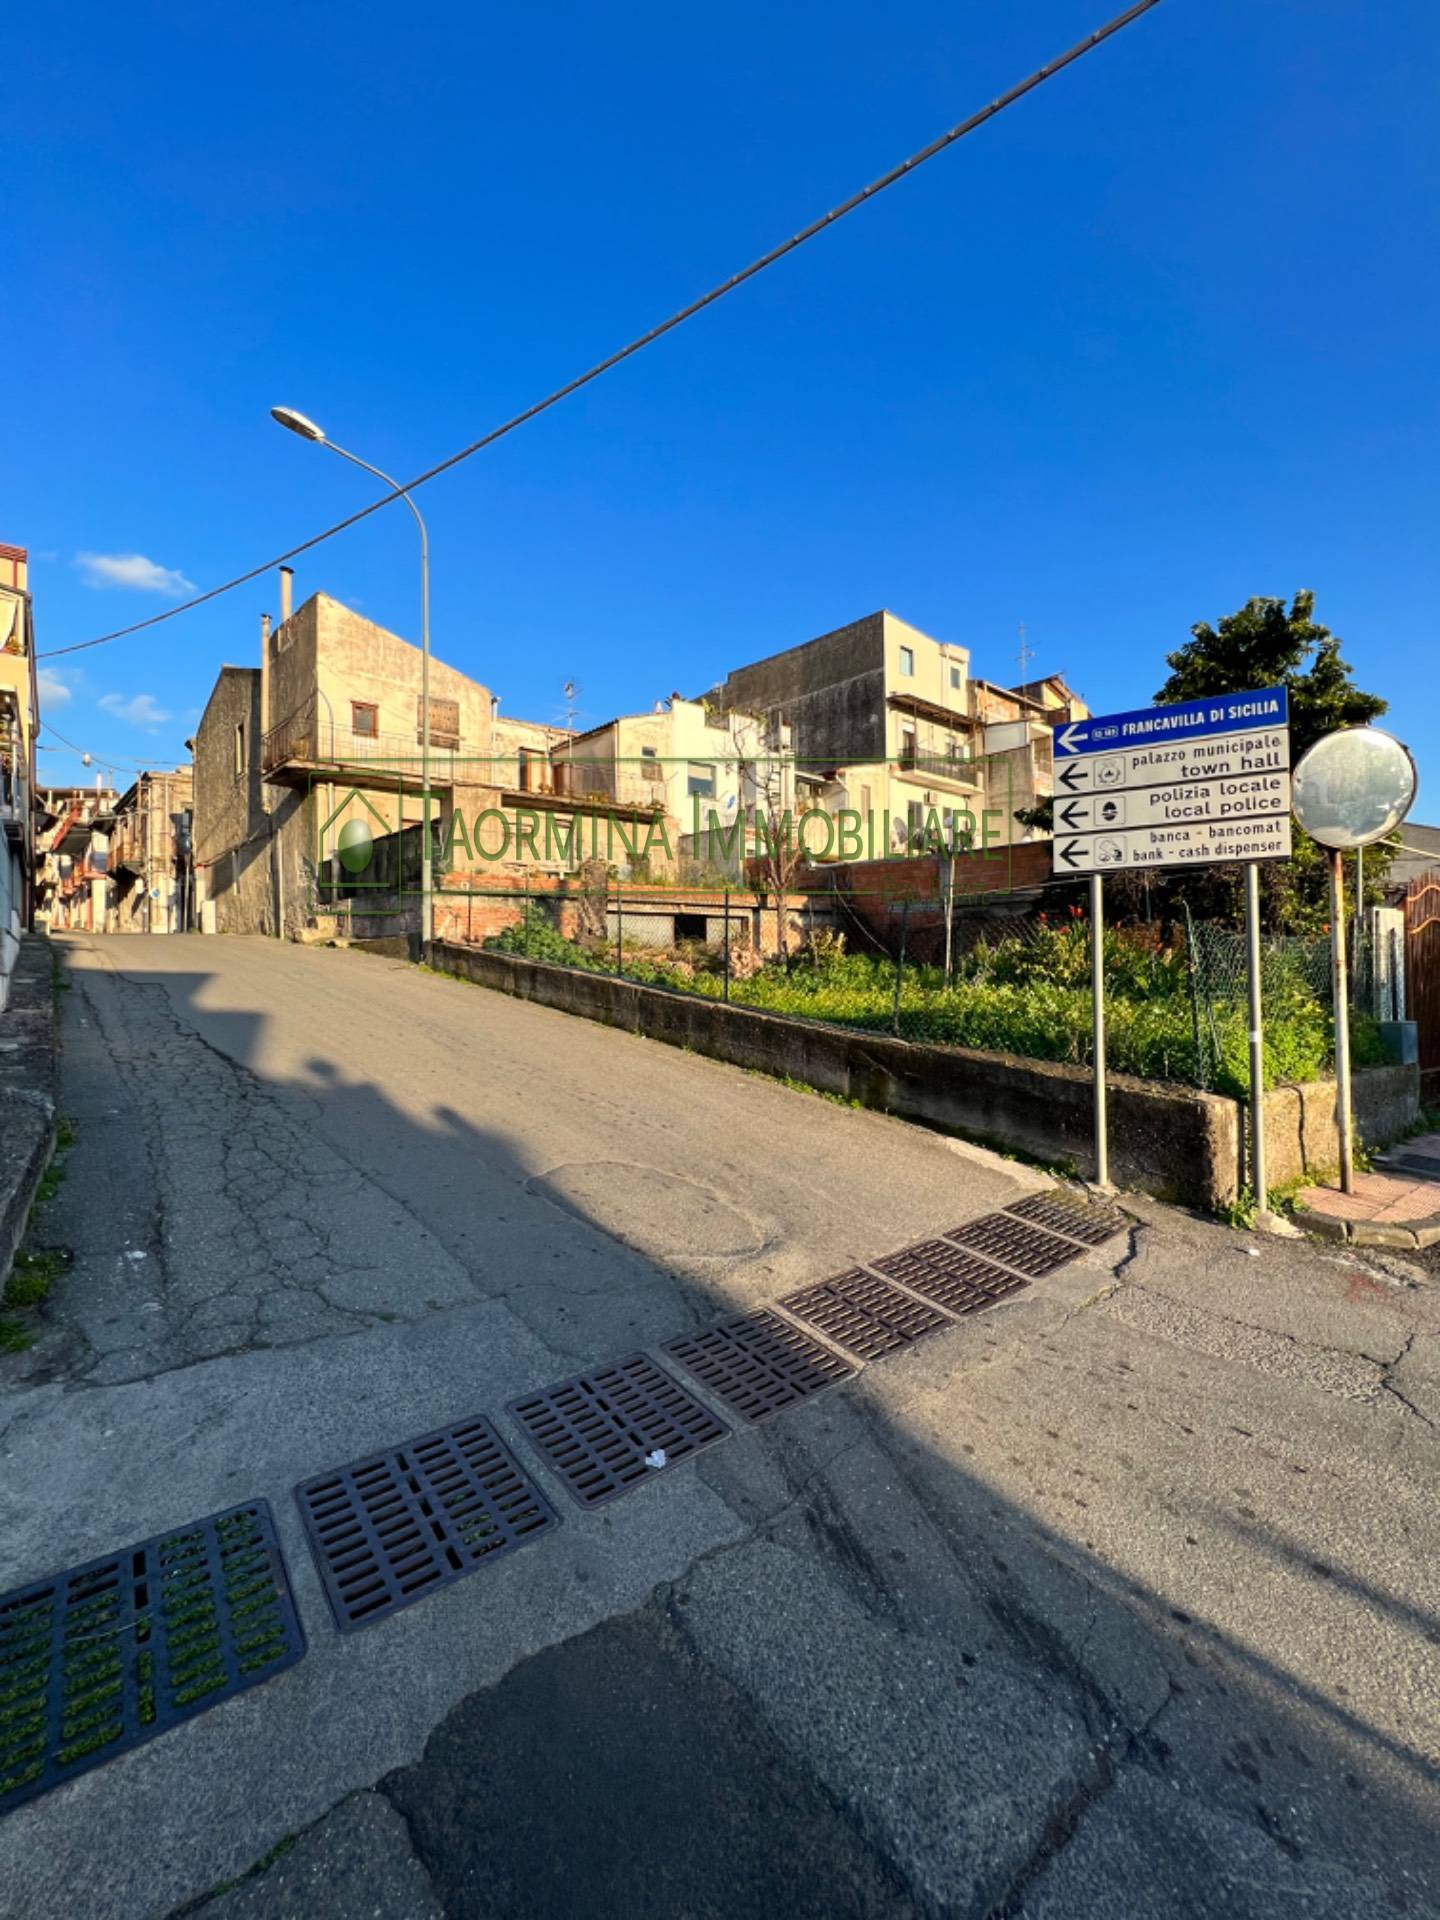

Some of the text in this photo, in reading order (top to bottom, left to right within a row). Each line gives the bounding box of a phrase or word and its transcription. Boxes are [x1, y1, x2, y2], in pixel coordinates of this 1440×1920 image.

[1122, 711, 1205, 737] FRANCAVILLA
[1210, 708, 1225, 723] DI
[1228, 699, 1280, 720] SICILIA
[1132, 735, 1281, 770] palazzo municipale
[1181, 752, 1281, 778] town hall
[1150, 777, 1281, 806] polizia locale
[1165, 795, 1281, 818] local police
[1150, 831, 1190, 844] banca
[1209, 820, 1281, 839] bancomat
[1132, 846, 1164, 862] bank
[1178, 843, 1210, 858] cash
[1215, 840, 1282, 857] dispenser
